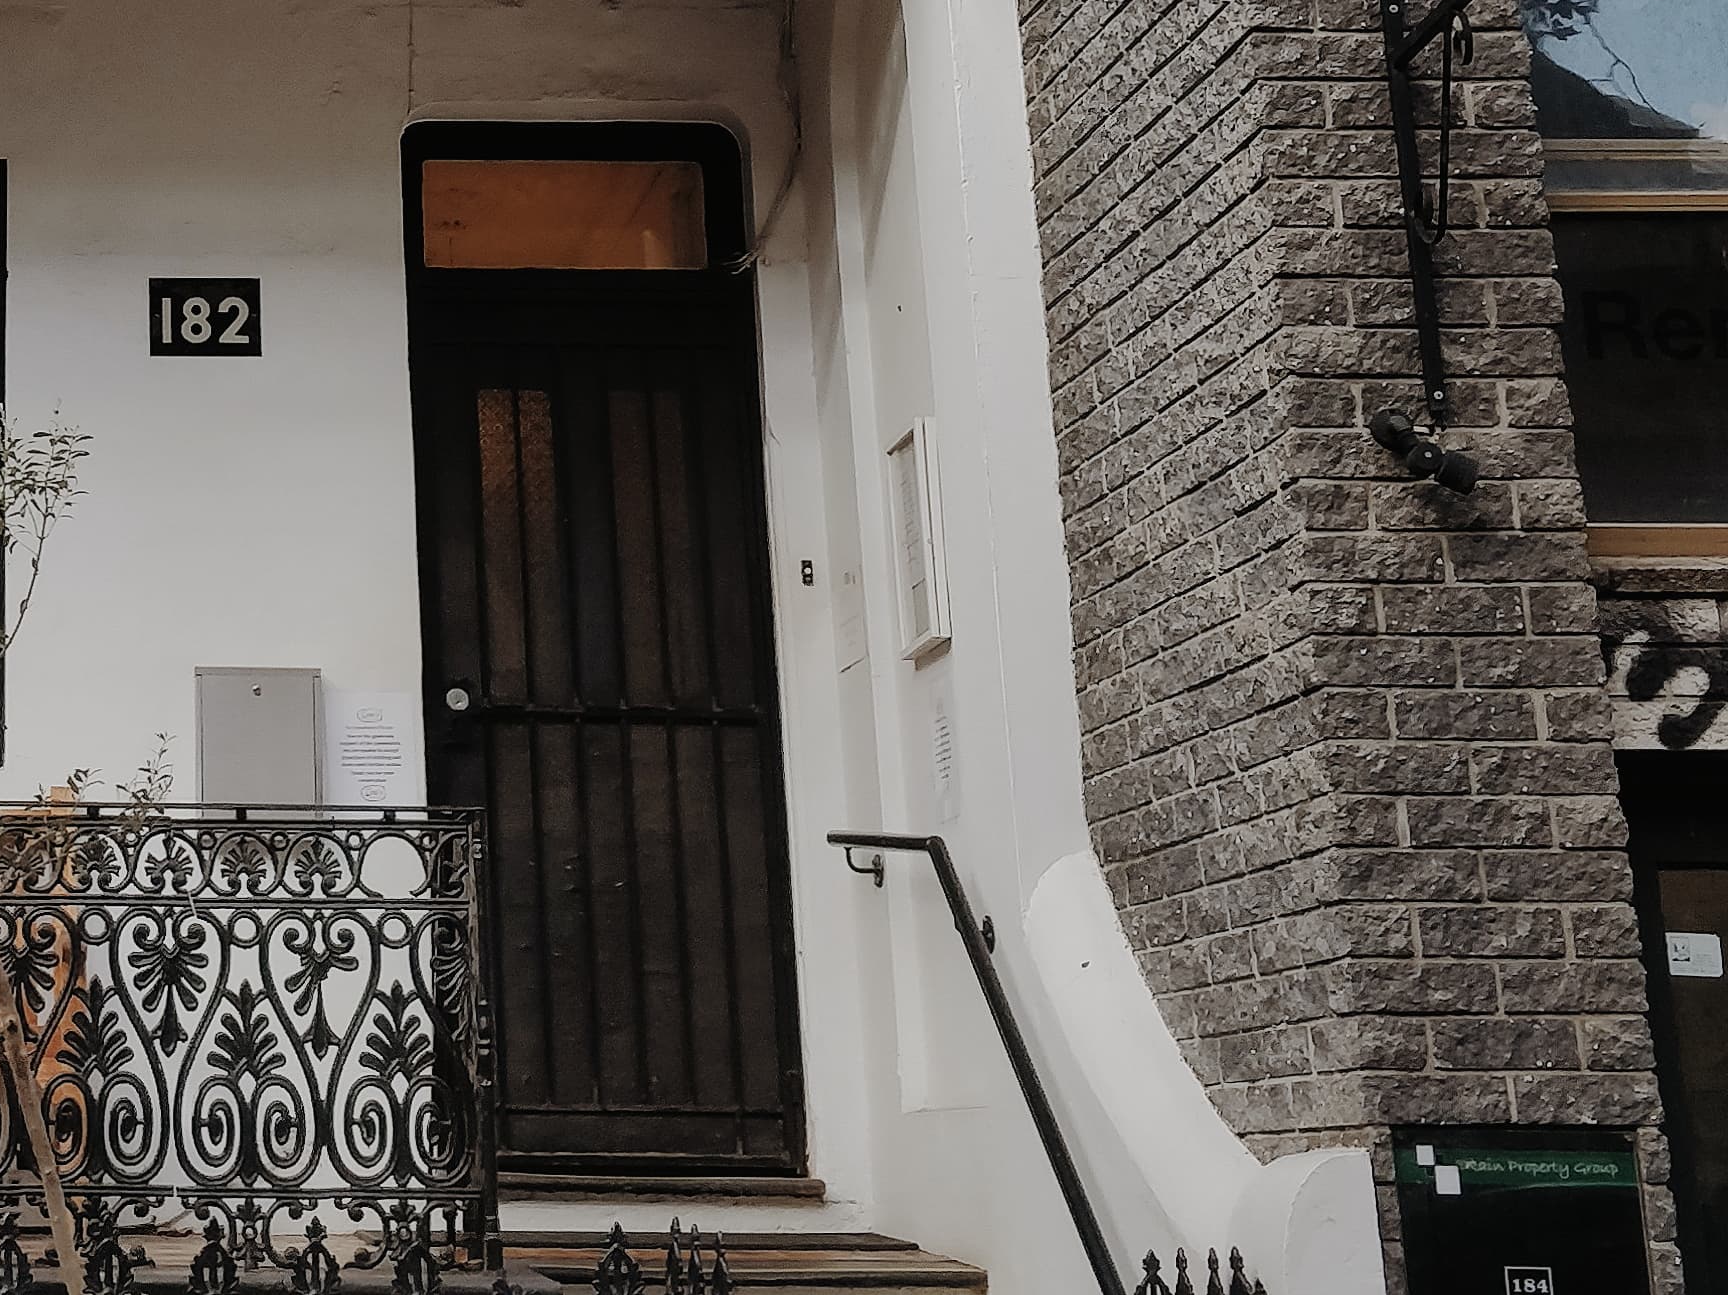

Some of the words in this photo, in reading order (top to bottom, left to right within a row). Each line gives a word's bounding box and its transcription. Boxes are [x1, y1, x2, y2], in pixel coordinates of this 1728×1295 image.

[161, 296, 250, 344] 182
[1507, 1160, 1570, 1179] Property
[1574, 1162, 1619, 1178] Group
[1512, 1278, 1549, 1294] 184
